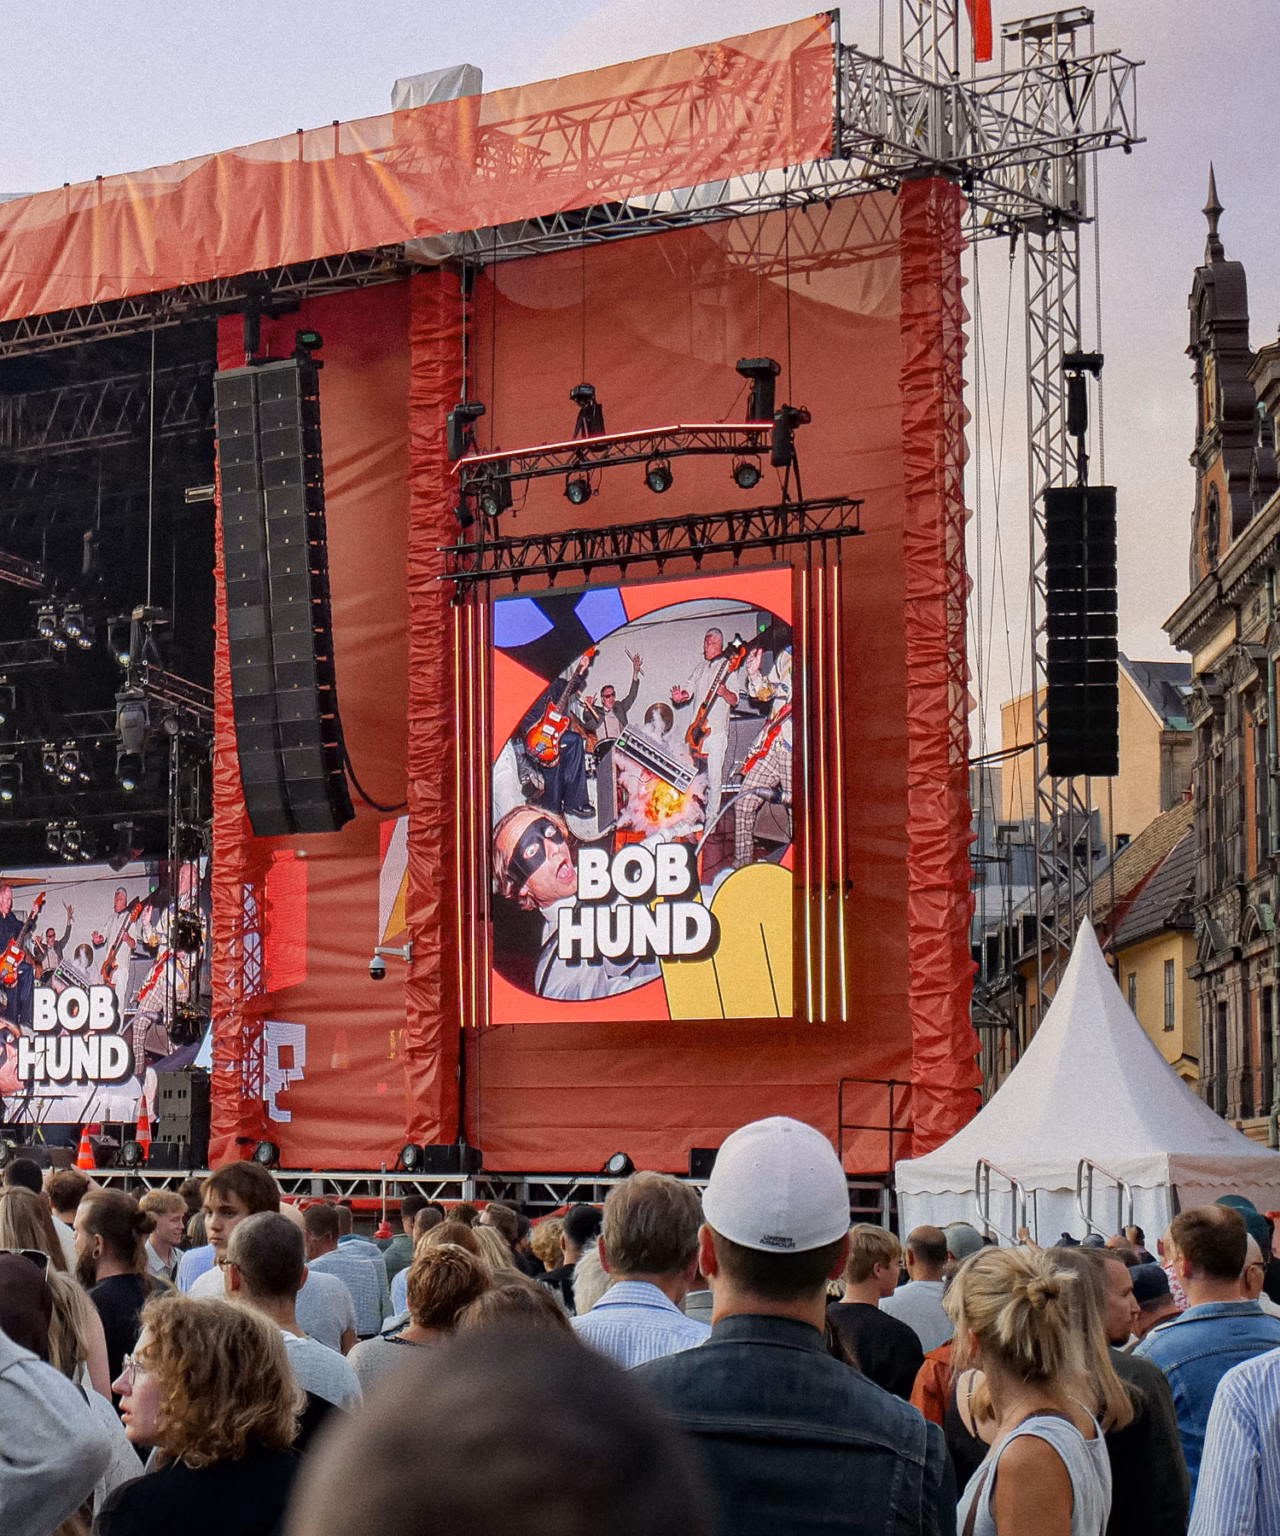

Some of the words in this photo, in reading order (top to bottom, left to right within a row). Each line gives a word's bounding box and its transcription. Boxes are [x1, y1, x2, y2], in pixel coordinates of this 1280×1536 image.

[578, 843, 692, 900] BOB
[558, 902, 712, 959] HUND
[33, 985, 115, 1031] BOB
[18, 1035, 130, 1080] HUND
